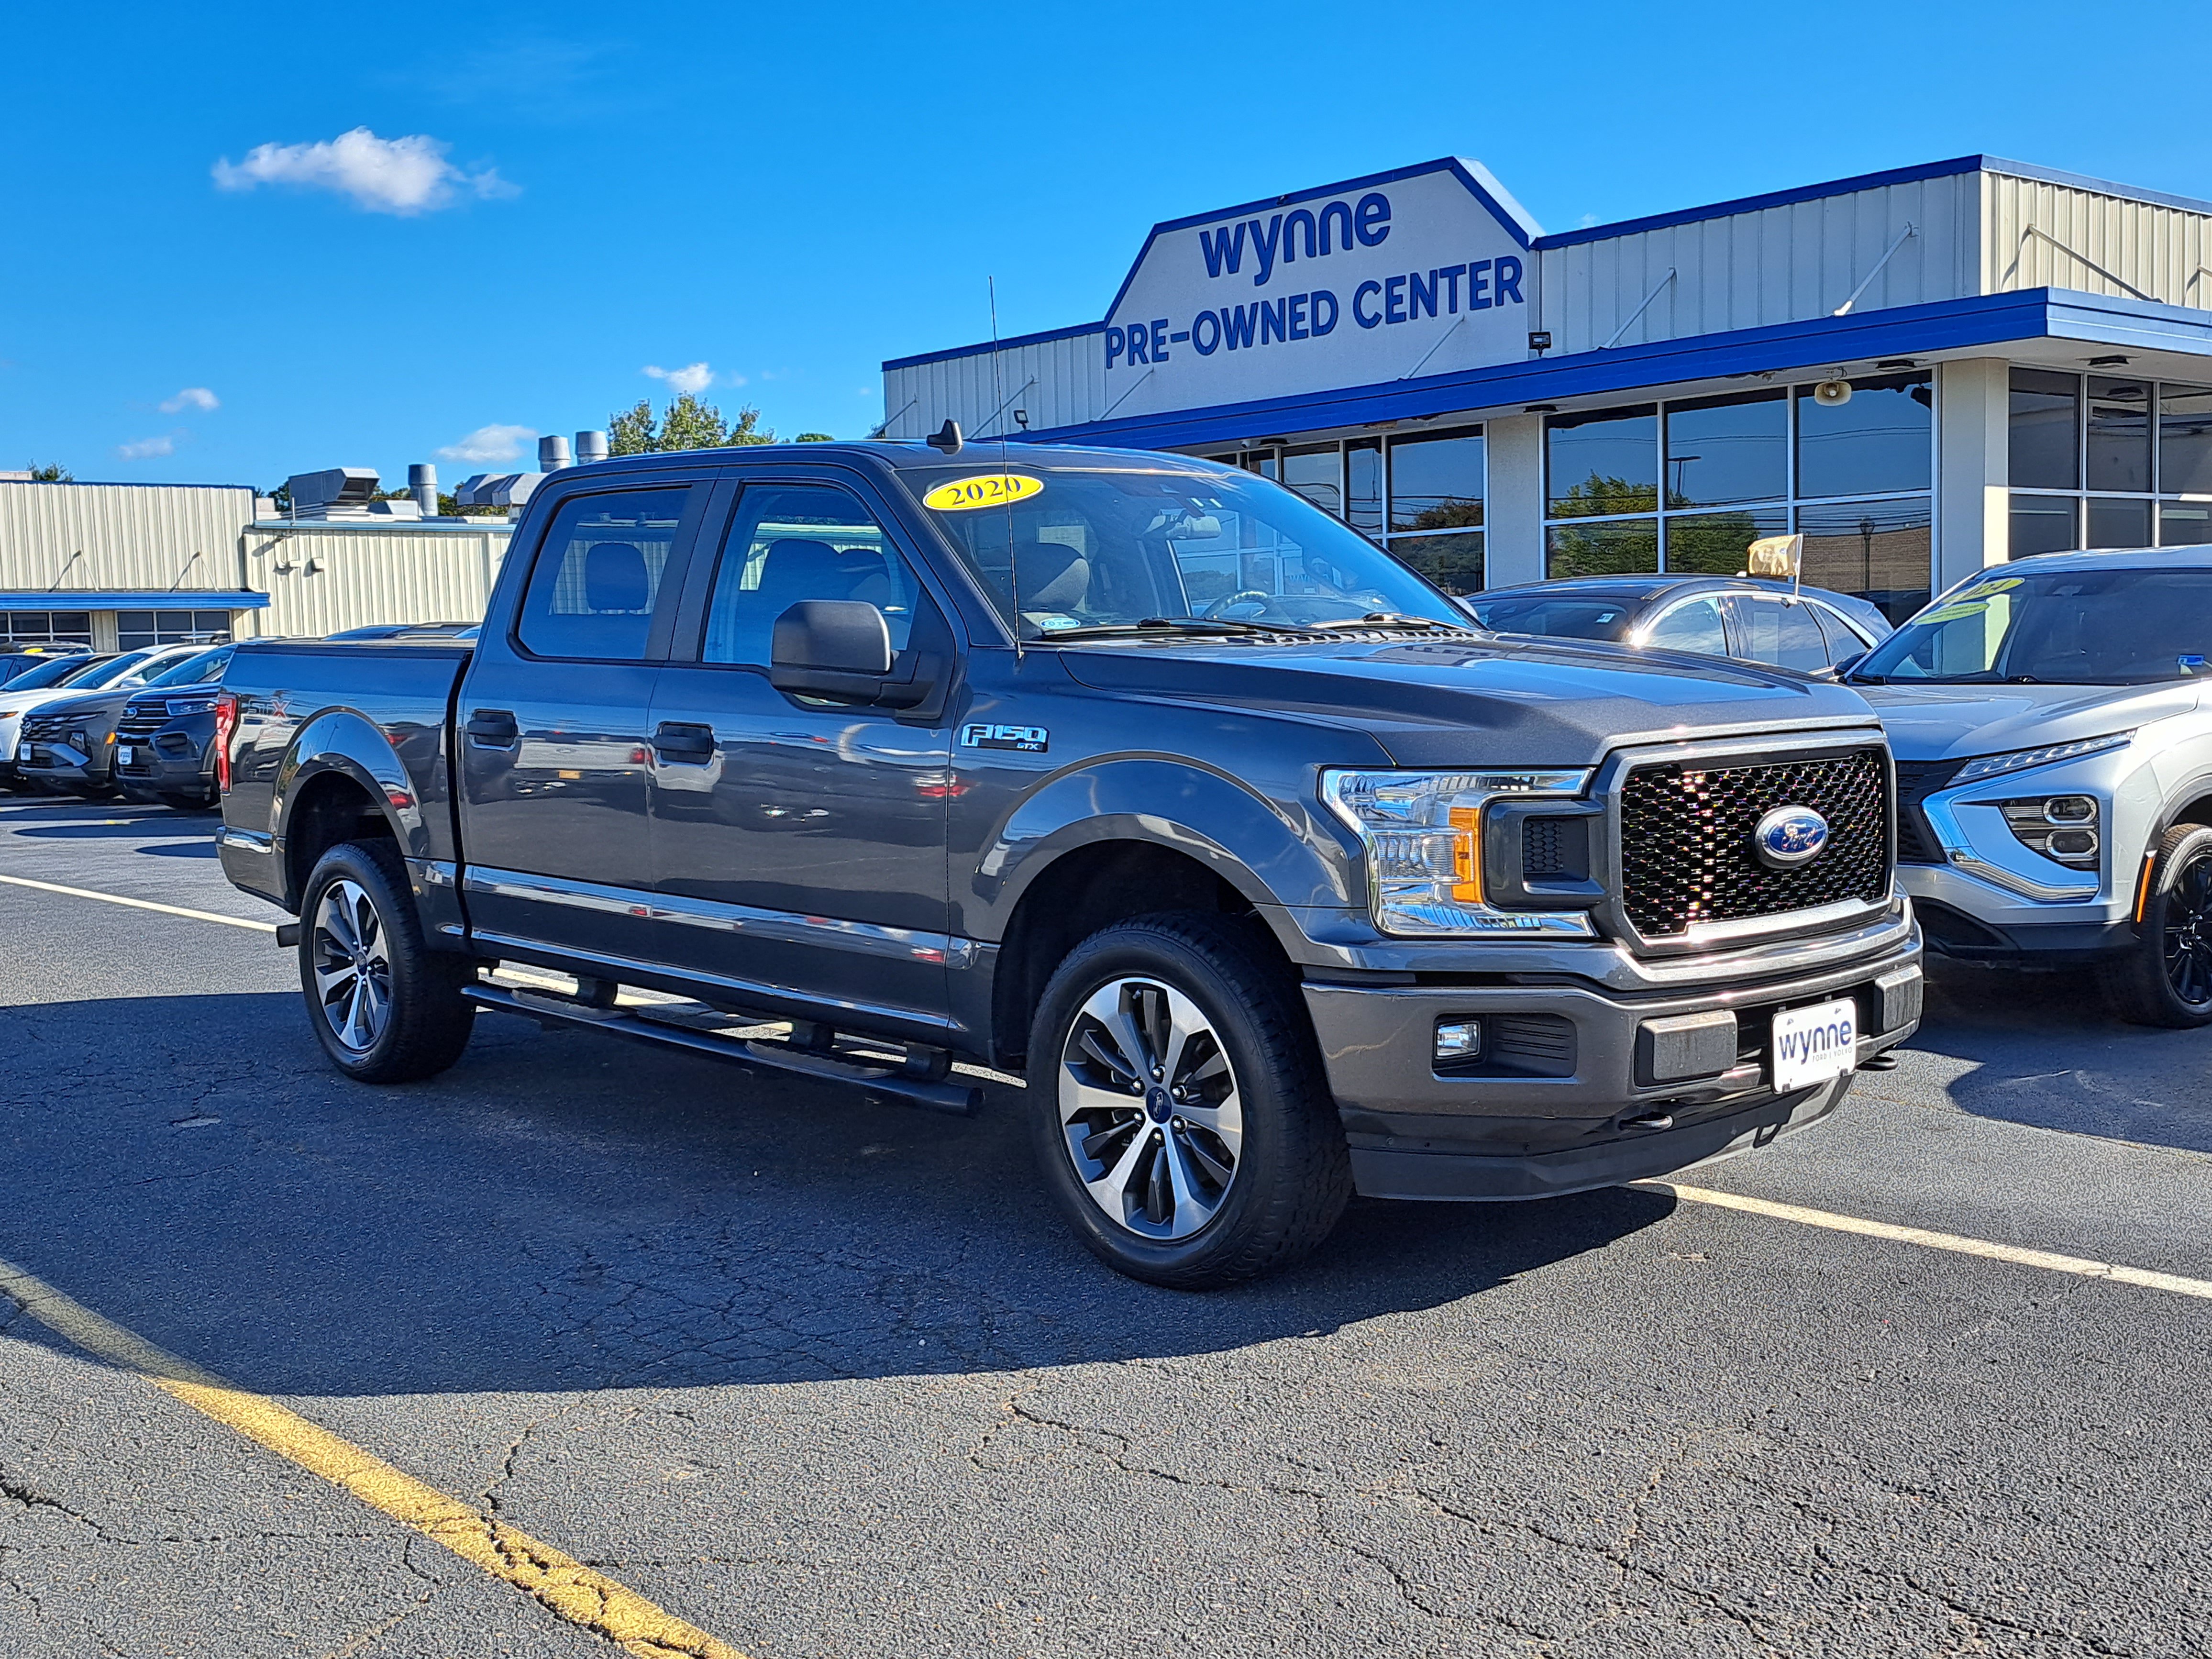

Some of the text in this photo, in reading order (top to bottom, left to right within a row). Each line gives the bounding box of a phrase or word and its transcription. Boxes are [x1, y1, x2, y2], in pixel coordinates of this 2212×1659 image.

[1199, 193, 1392, 287] wynne
[1105, 255, 1524, 370] PRE-OWNED CENTER
[947, 477, 1021, 506] 2020
[1778, 1020, 1852, 1065] wynne
[1812, 1046, 1853, 1063] FORD VOLVO
